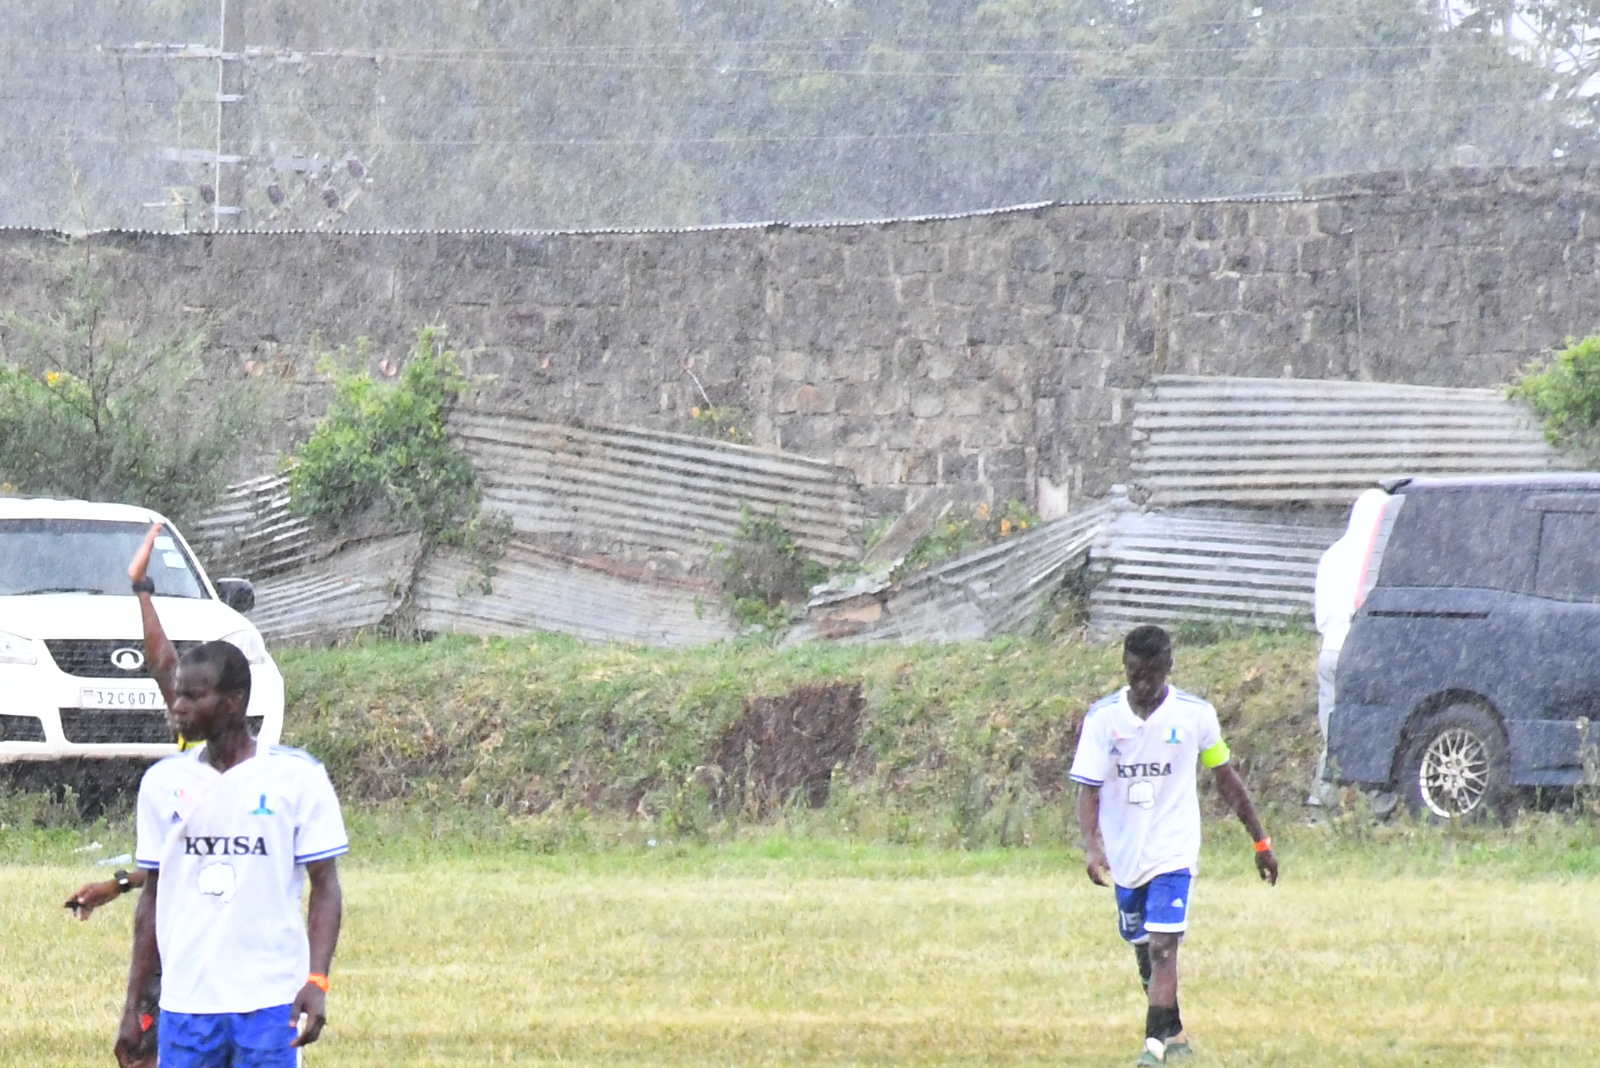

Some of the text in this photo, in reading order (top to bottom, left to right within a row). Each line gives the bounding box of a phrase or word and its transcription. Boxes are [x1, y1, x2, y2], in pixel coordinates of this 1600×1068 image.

[97, 691, 166, 705] 32CG07
[1116, 762, 1172, 778] KYISA
[184, 836, 268, 856] KYISA
